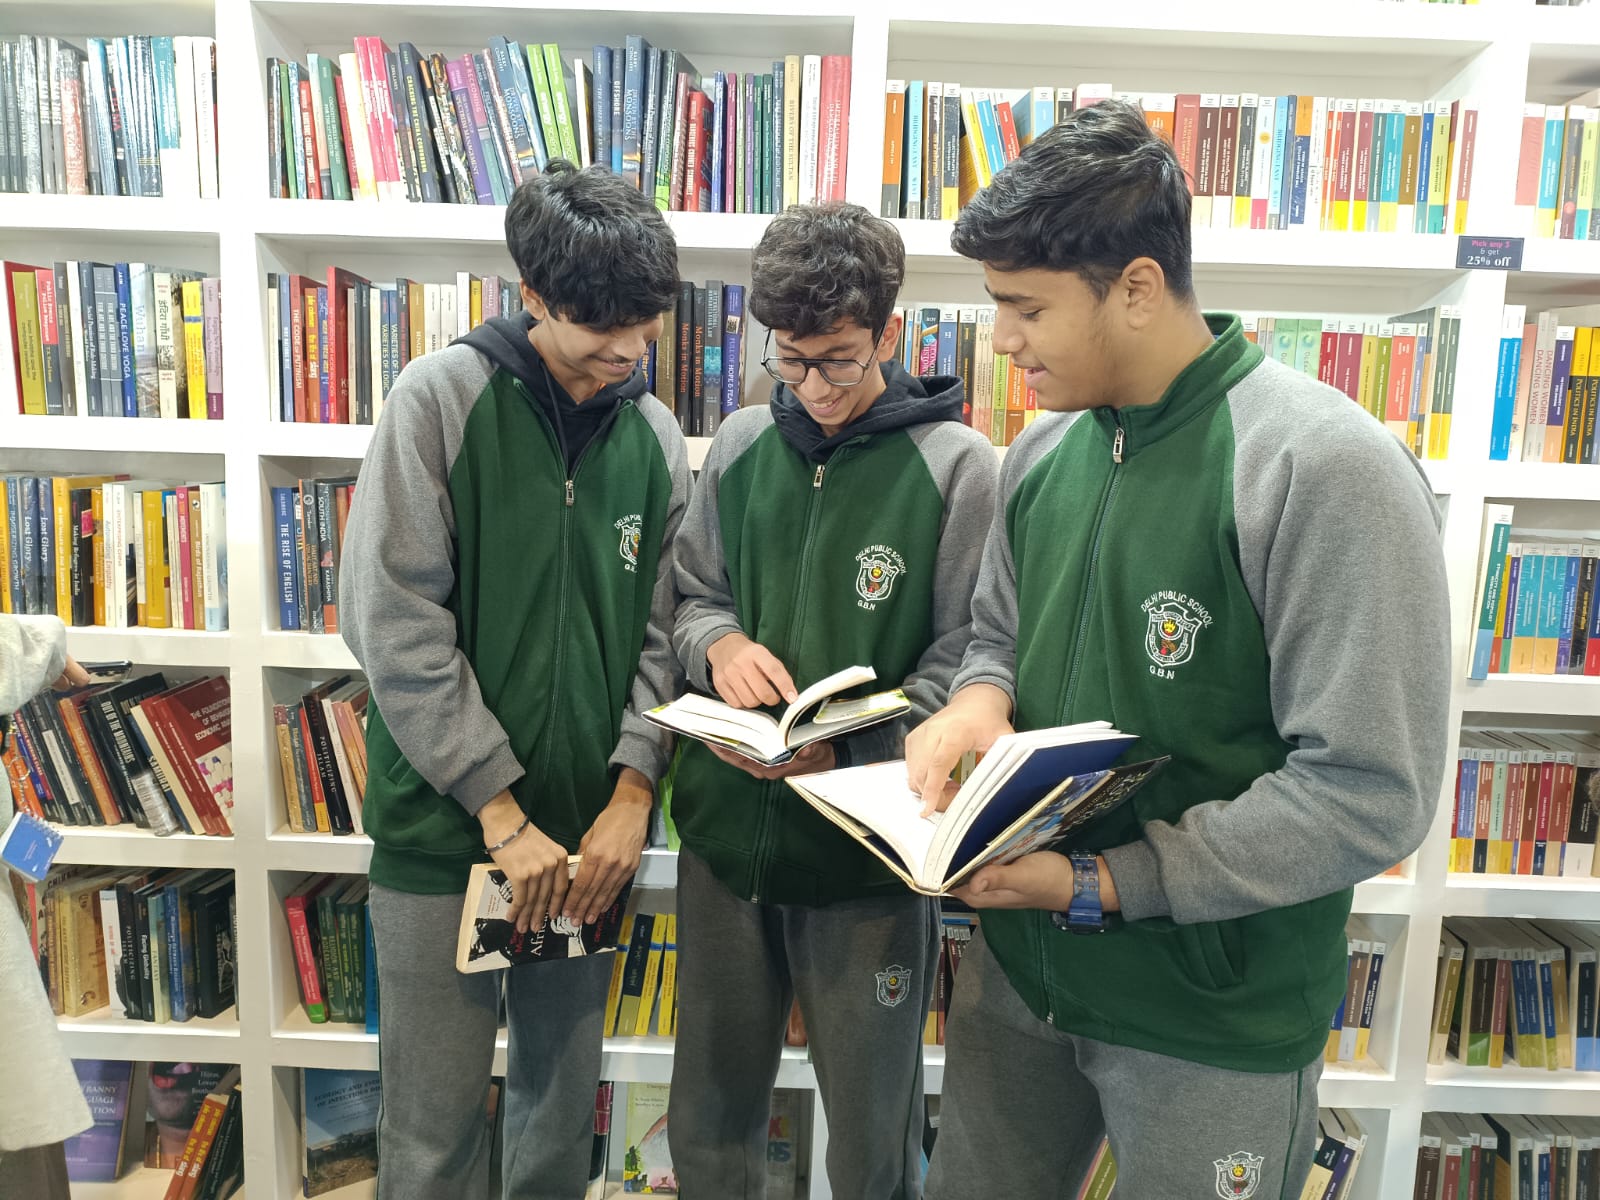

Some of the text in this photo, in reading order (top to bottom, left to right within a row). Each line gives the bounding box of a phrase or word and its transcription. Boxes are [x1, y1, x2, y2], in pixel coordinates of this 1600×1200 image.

[466, 70, 481, 112] RECKONING
[406, 75, 417, 105] CRACKING
[413, 119, 422, 136] CHINA
[504, 88, 520, 139] MONSOONS
[556, 91, 567, 125] energy
[455, 94, 479, 175] SPECTRUM MANAGEMENT
[632, 117, 637, 125] BY
[788, 127, 794, 135] OF
[1466, 256, 1512, 266] 25% off
[136, 305, 145, 353] Wuhan
[695, 326, 703, 354] Monks
[309, 362, 318, 378] slang
[383, 360, 389, 368] OF
[392, 360, 398, 368] OF
[680, 322, 689, 393] Monks in Motion
[695, 356, 702, 364] in
[729, 354, 735, 363] OF
[1529, 350, 1544, 424] DANCING WOMEN
[1539, 351, 1552, 424] DANCING WOMEN
[1573, 379, 1582, 406] POLITICS
[1588, 379, 1598, 407] POLITICS
[1570, 417, 1578, 436] INDIA
[24, 537, 32, 561] Glory
[41, 537, 49, 562] Glory
[282, 540, 290, 557] RISE
[871, 544, 893, 554] PUBLIC
[105, 561, 113, 589] Empathy
[283, 560, 290, 569] OF
[284, 572, 293, 603] ENGLISH
[1140, 590, 1214, 628] DELHI PUBLIC SCHOOL
[101, 701, 112, 713] OUT
[110, 720, 119, 731] THE
[19, 724, 28, 739] WHITE
[33, 761, 43, 776] CLASS
[114, 730, 135, 763] MOUNTAINS
[148, 755, 171, 792] SAMURAI
[317, 753, 326, 778] ISLAM
[319, 736, 336, 793] POLITICIZING
[126, 925, 135, 981] POLITICIZING
[140, 935, 148, 953] Facing
